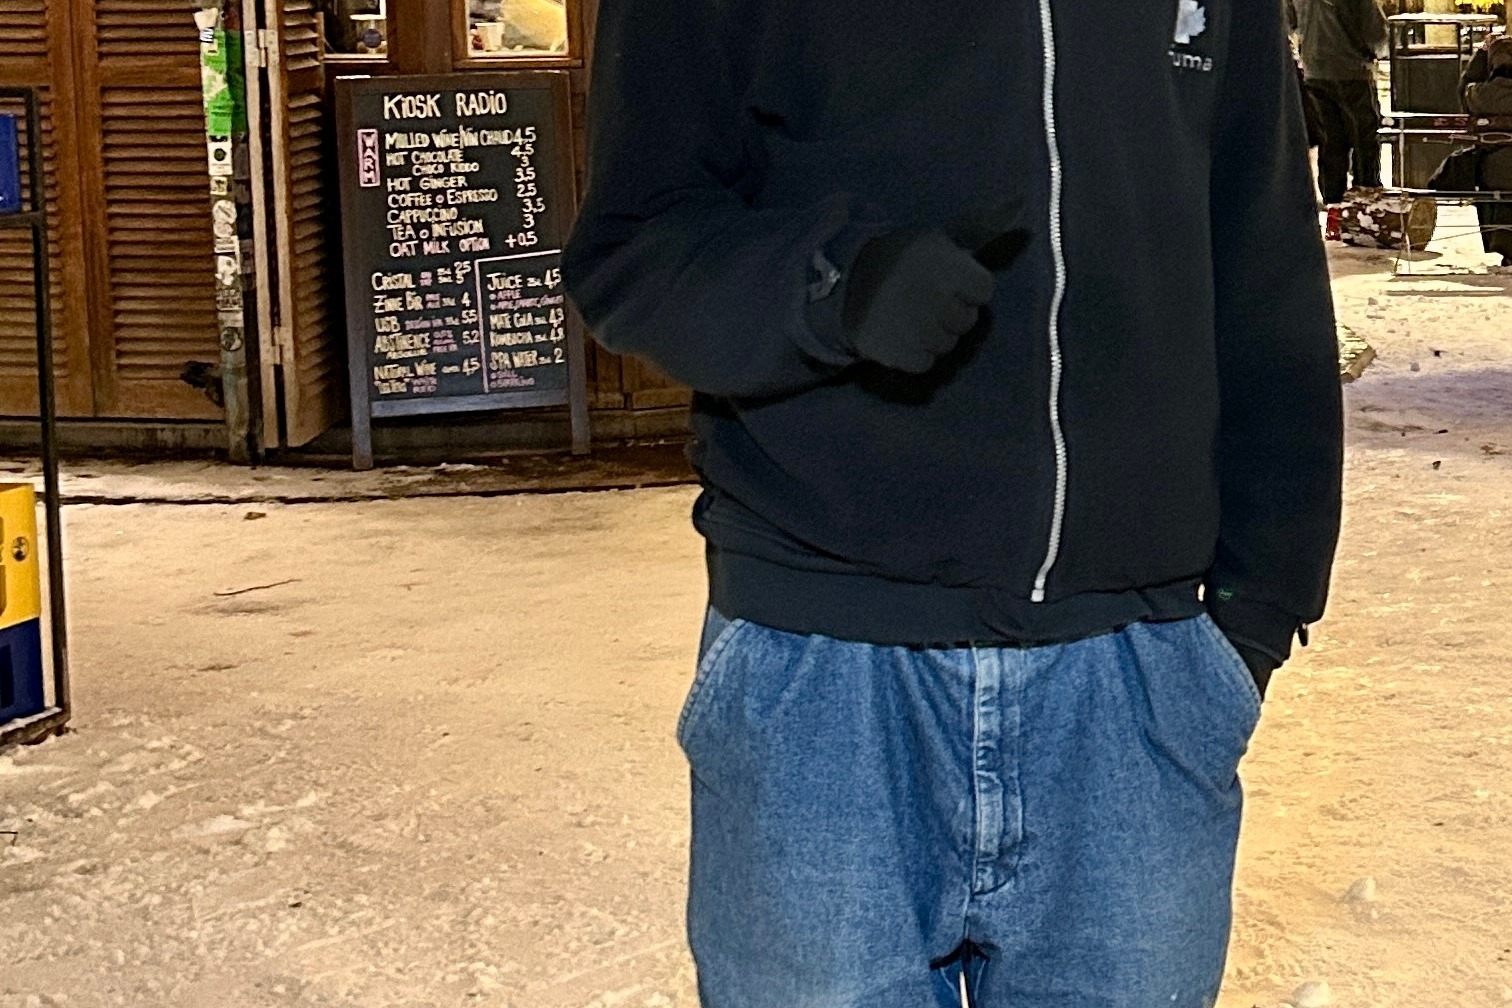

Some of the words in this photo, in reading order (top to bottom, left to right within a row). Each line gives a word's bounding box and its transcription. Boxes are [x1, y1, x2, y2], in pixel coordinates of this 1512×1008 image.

[386, 151, 409, 166] HOT
[520, 156, 530, 167] 3
[387, 177, 412, 192] HOT
[387, 193, 432, 208] COFFEE
[387, 224, 416, 241] TEA
[522, 214, 535, 228] 3
[389, 241, 418, 257] OAT
[461, 291, 471, 307] 4
[554, 347, 565, 363] 2
